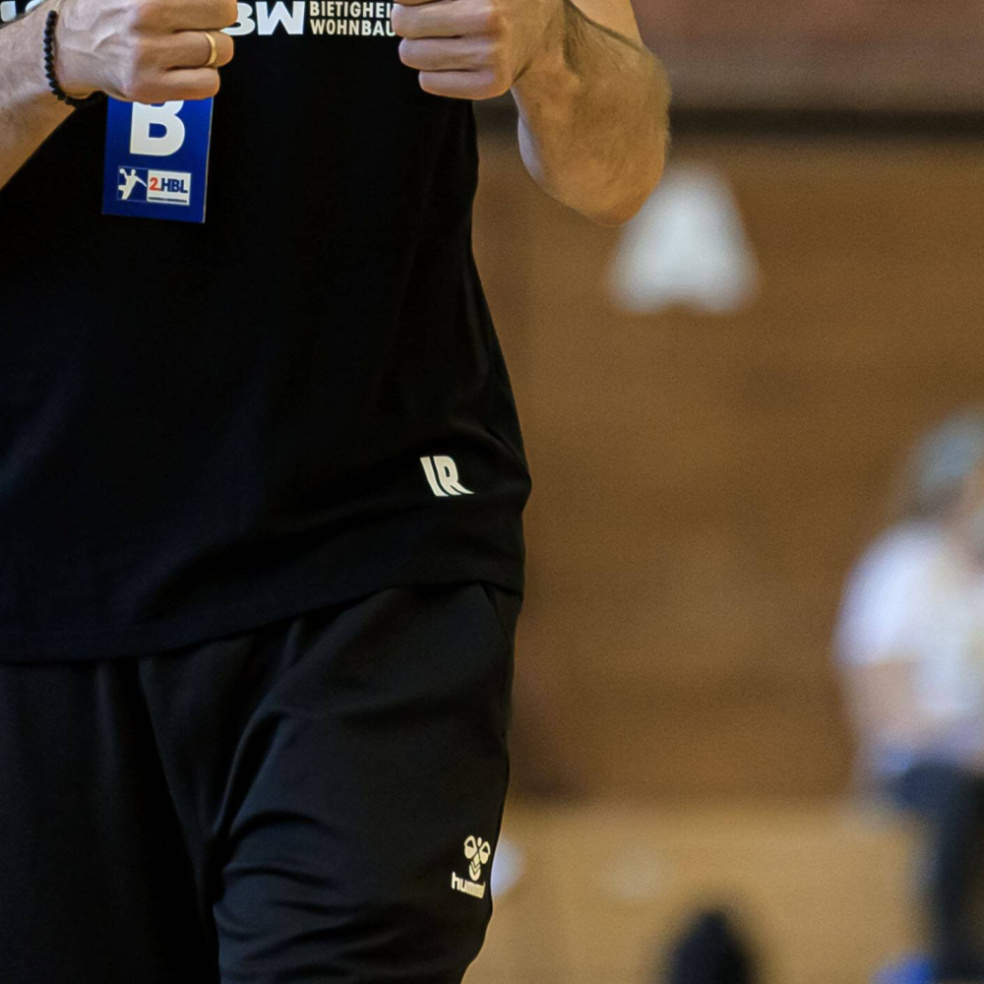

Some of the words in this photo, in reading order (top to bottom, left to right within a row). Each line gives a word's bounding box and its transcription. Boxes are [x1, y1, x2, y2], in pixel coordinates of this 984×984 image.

[309, 0, 392, 19] BIETIGHEI
[129, 99, 186, 157] B
[149, 177, 188, 194] 2.HBL
